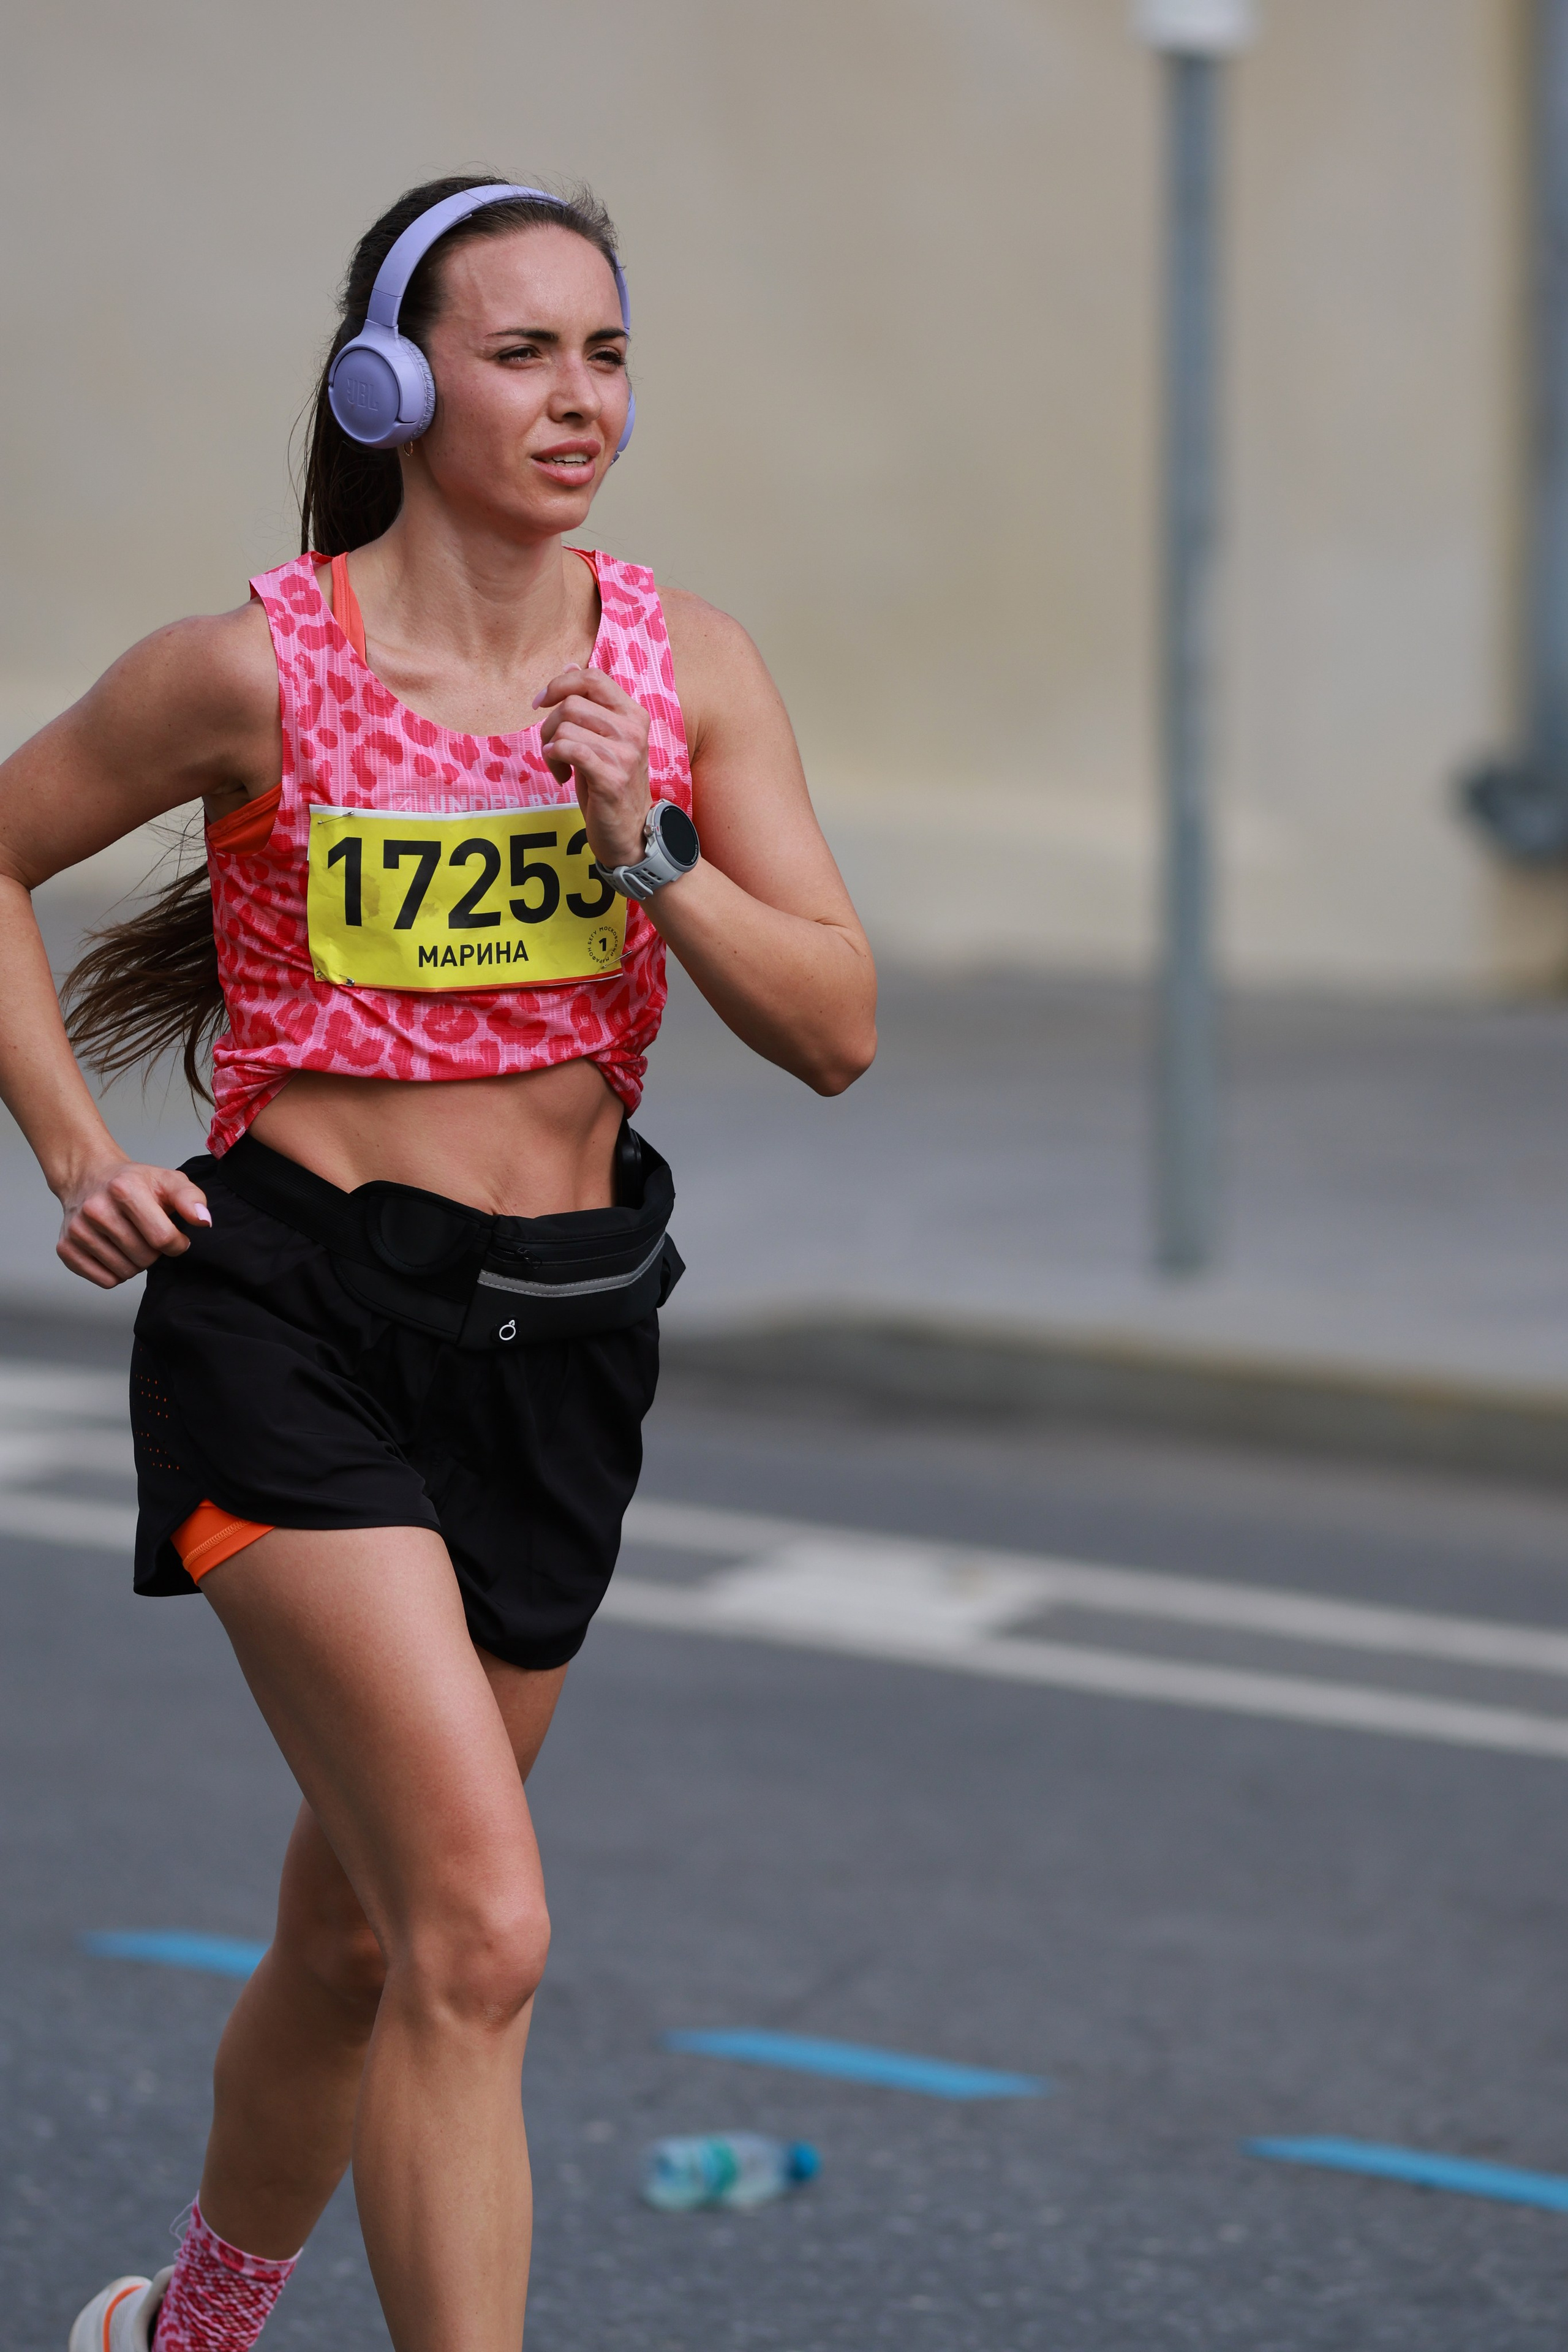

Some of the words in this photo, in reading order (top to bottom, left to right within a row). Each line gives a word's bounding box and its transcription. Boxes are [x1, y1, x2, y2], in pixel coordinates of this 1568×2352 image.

[347, 377, 379, 412] JBL
[327, 828, 616, 930] 17253
[418, 940, 529, 968] МАРИНА
[598, 937, 606, 952] 1
